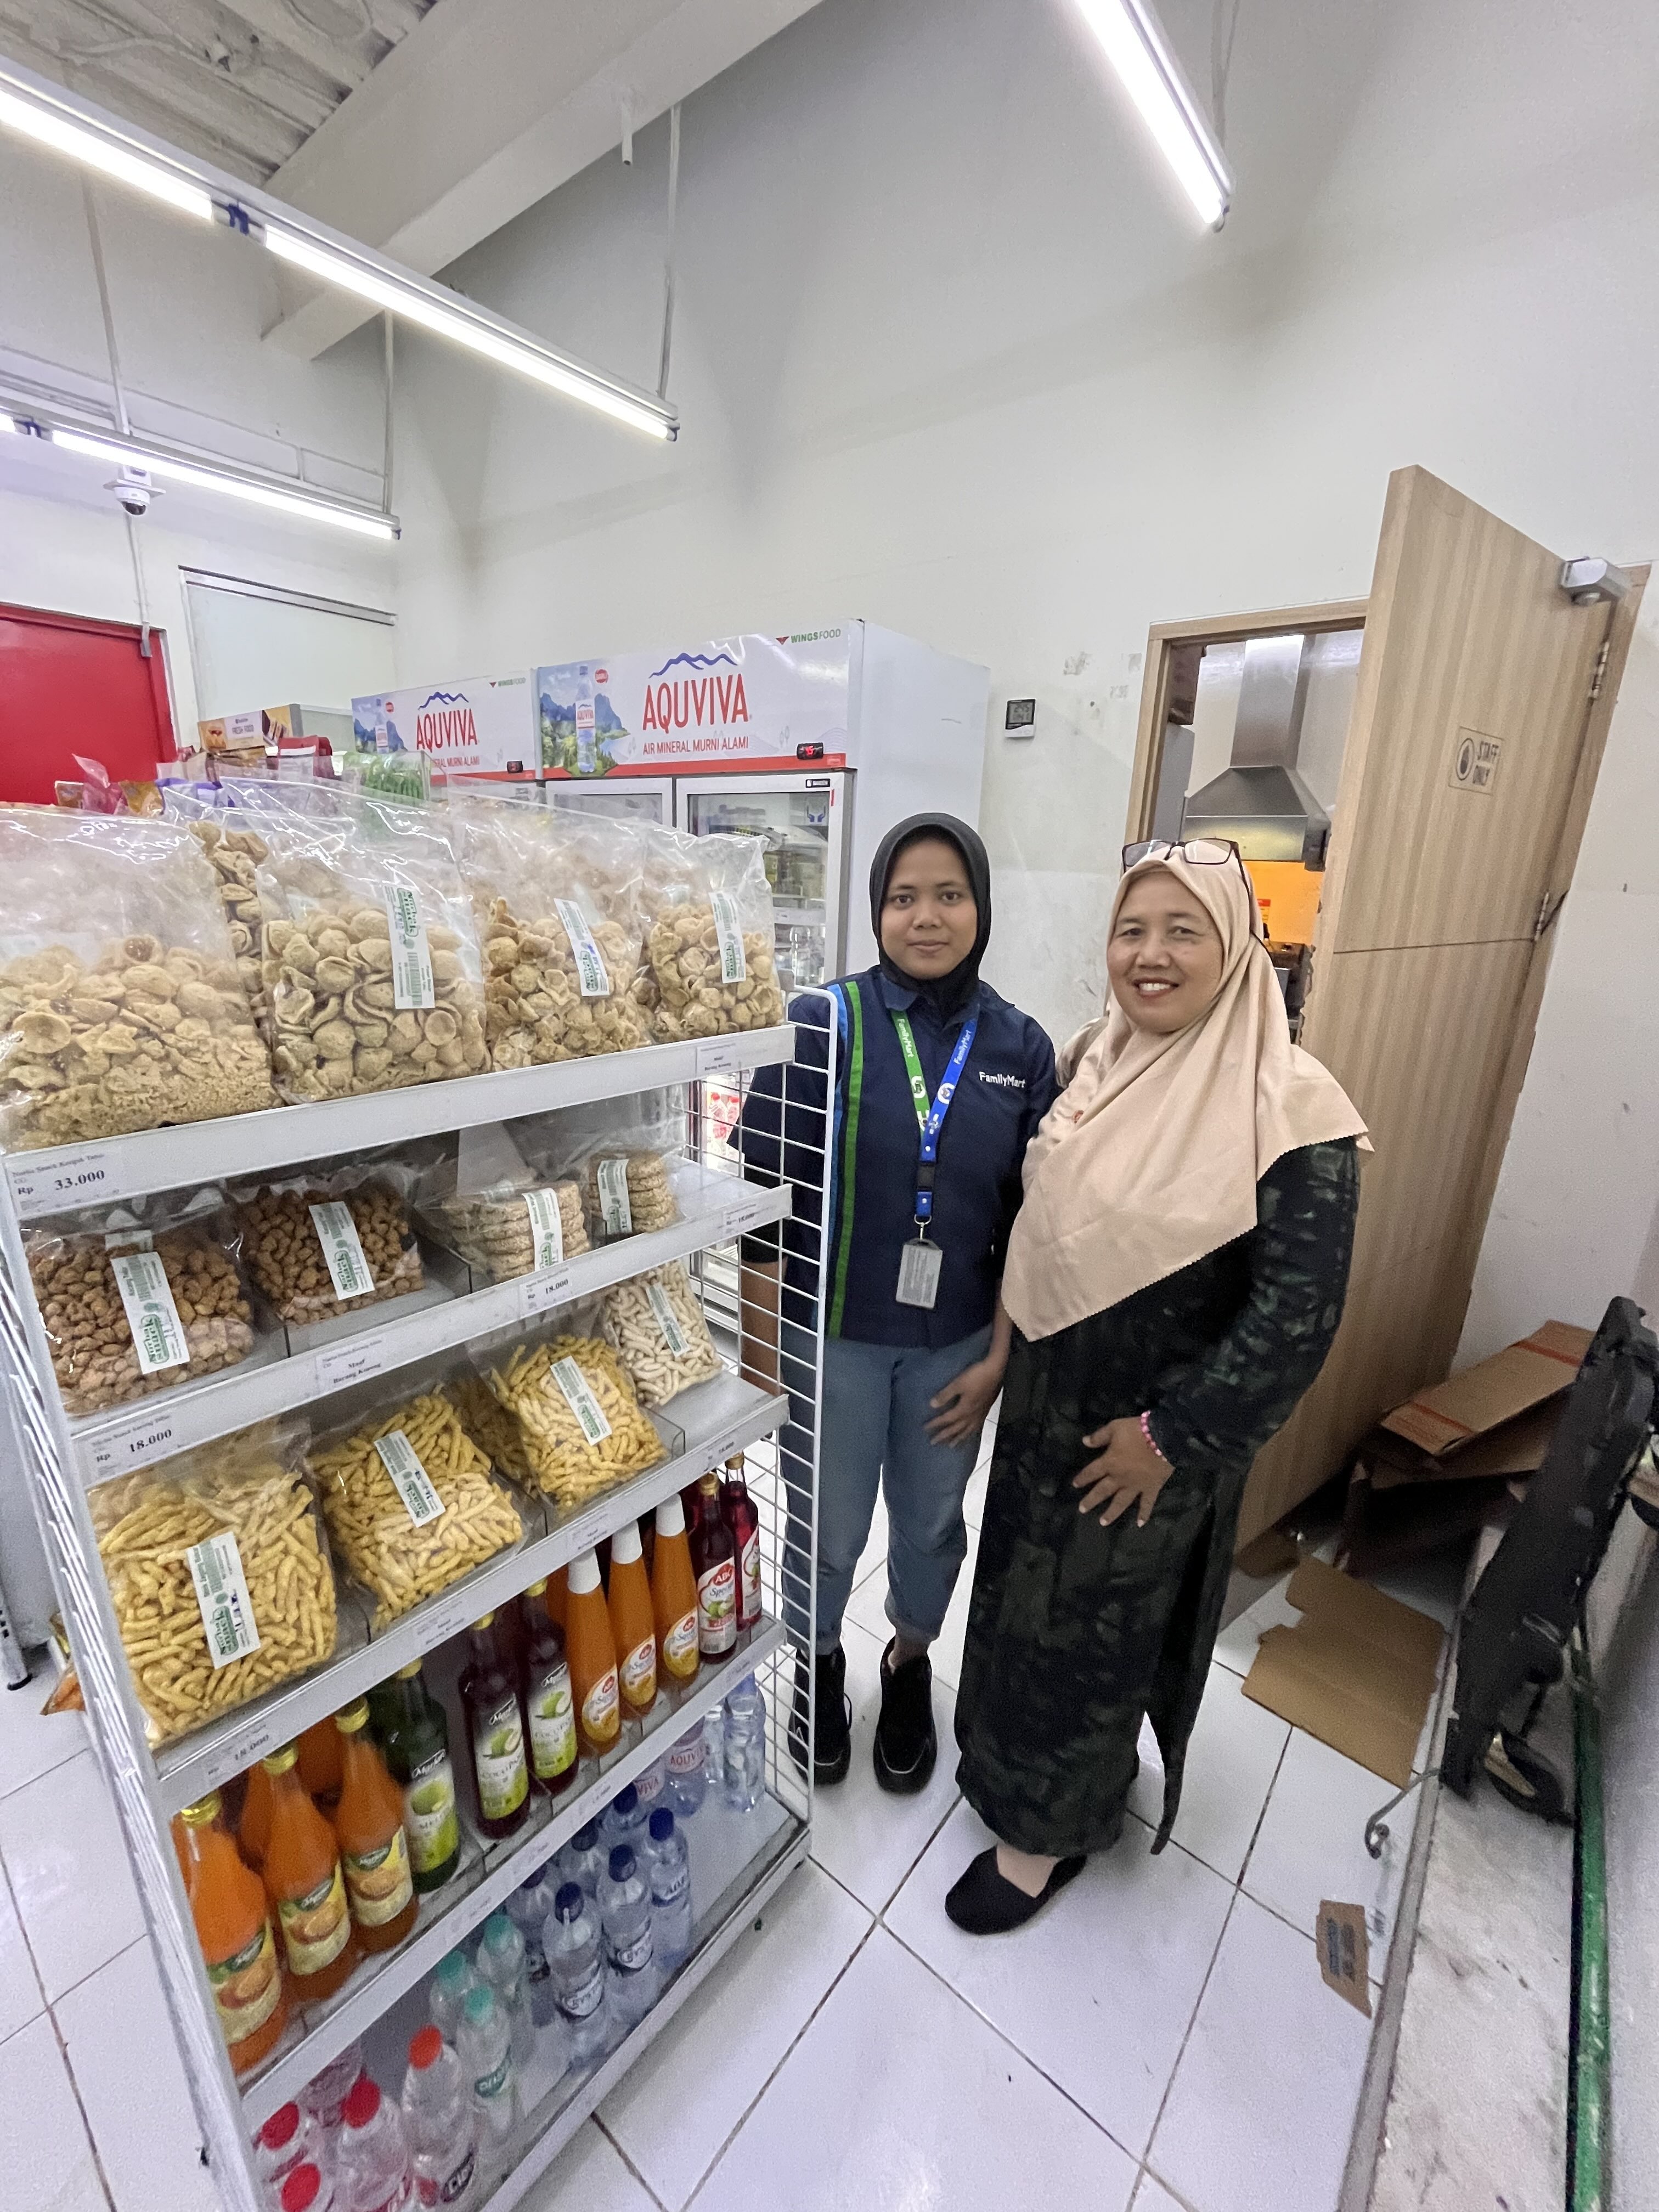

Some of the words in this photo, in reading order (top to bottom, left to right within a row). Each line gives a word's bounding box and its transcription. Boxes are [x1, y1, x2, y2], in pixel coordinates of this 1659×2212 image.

[642, 673, 749, 733] AQUVIVA
[416, 708, 478, 753] AQUVIVA
[642, 742, 655, 755] AIR
[657, 741, 690, 754] MINERAL
[693, 738, 719, 752] MURNI
[722, 736, 749, 750] ALAMI
[898, 1019, 914, 1057] FamilyMart
[953, 1030, 972, 1064] FamilyMart
[979, 1071, 1026, 1088] FamilyMart
[18, 1187, 34, 1195] Rp
[54, 1170, 105, 1190] 33.000
[545, 1279, 568, 1294] 18.000
[129, 1429, 172, 1452] 18.000
[715, 1567, 733, 1584] ABC
